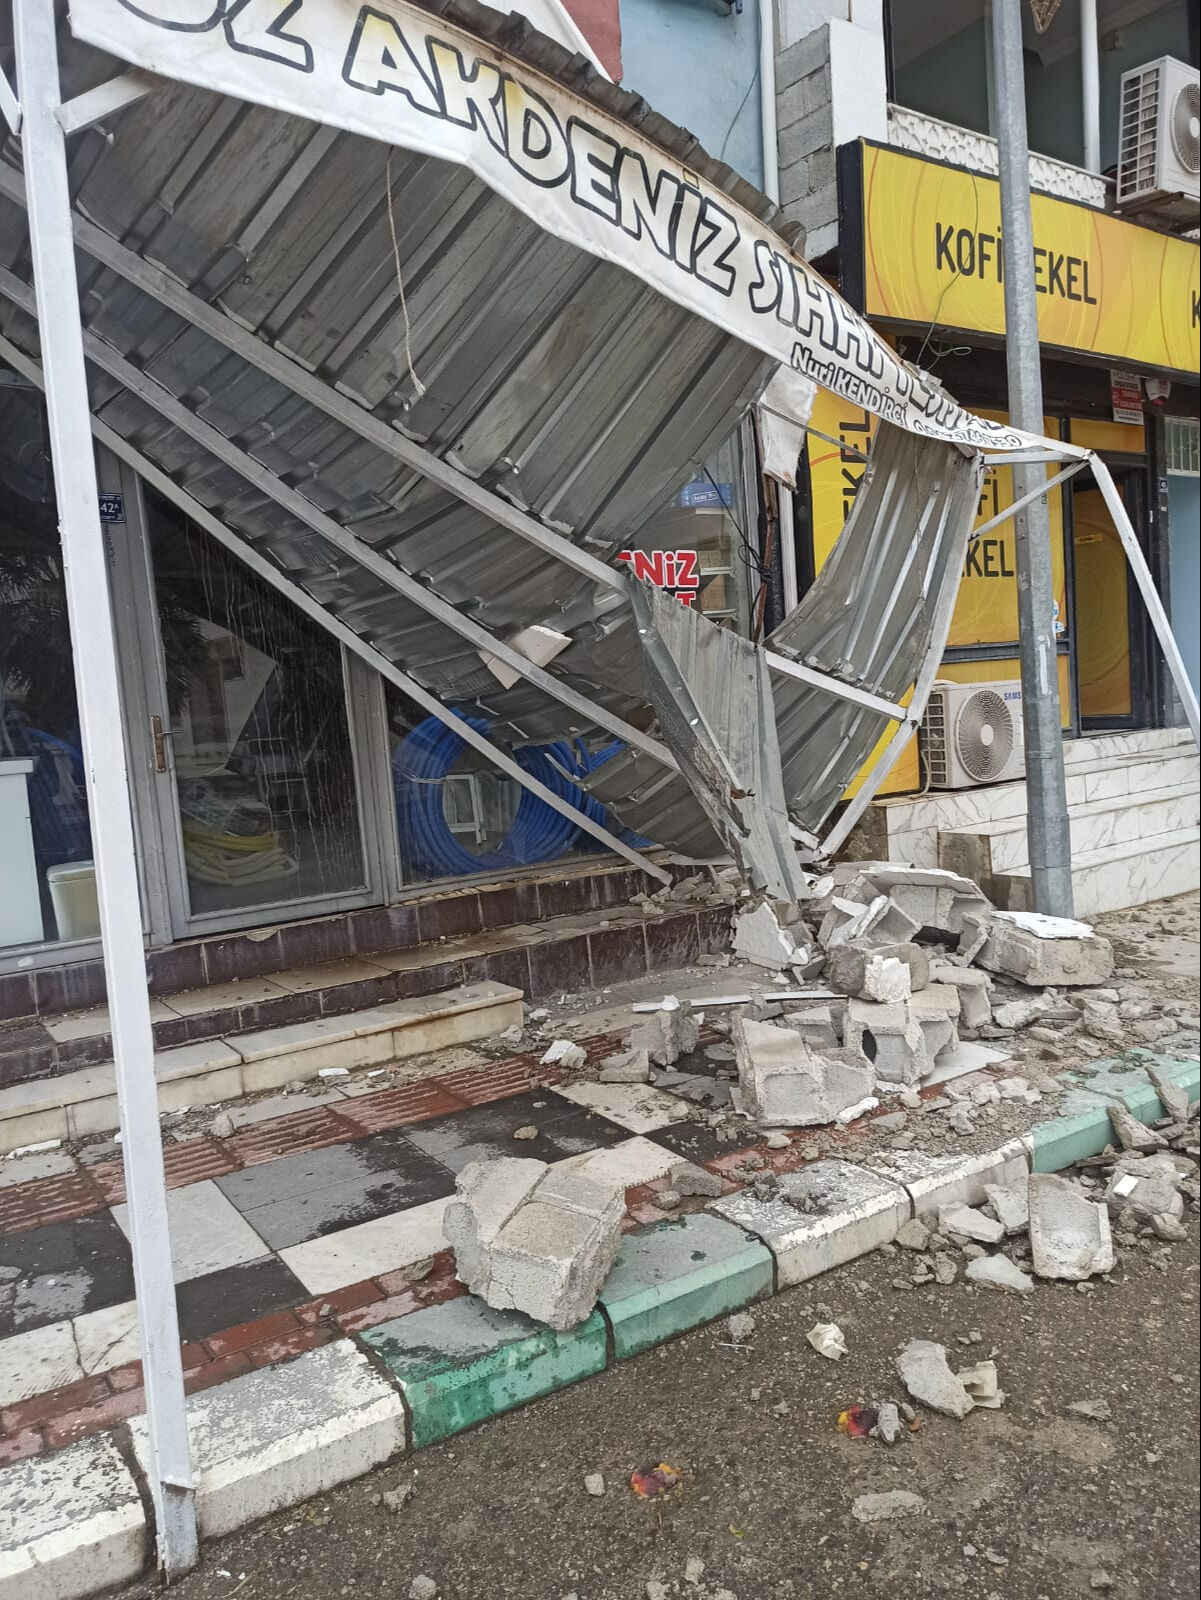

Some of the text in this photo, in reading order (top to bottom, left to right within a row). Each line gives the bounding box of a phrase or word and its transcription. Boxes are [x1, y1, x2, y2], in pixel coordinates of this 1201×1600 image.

[343, 5, 741, 297] AKDENİZ
[1033, 246, 1097, 305] EKEL
[839, 409, 871, 522] KEL
[616, 549, 699, 588] NiZ
[961, 539, 1014, 578] KEL
